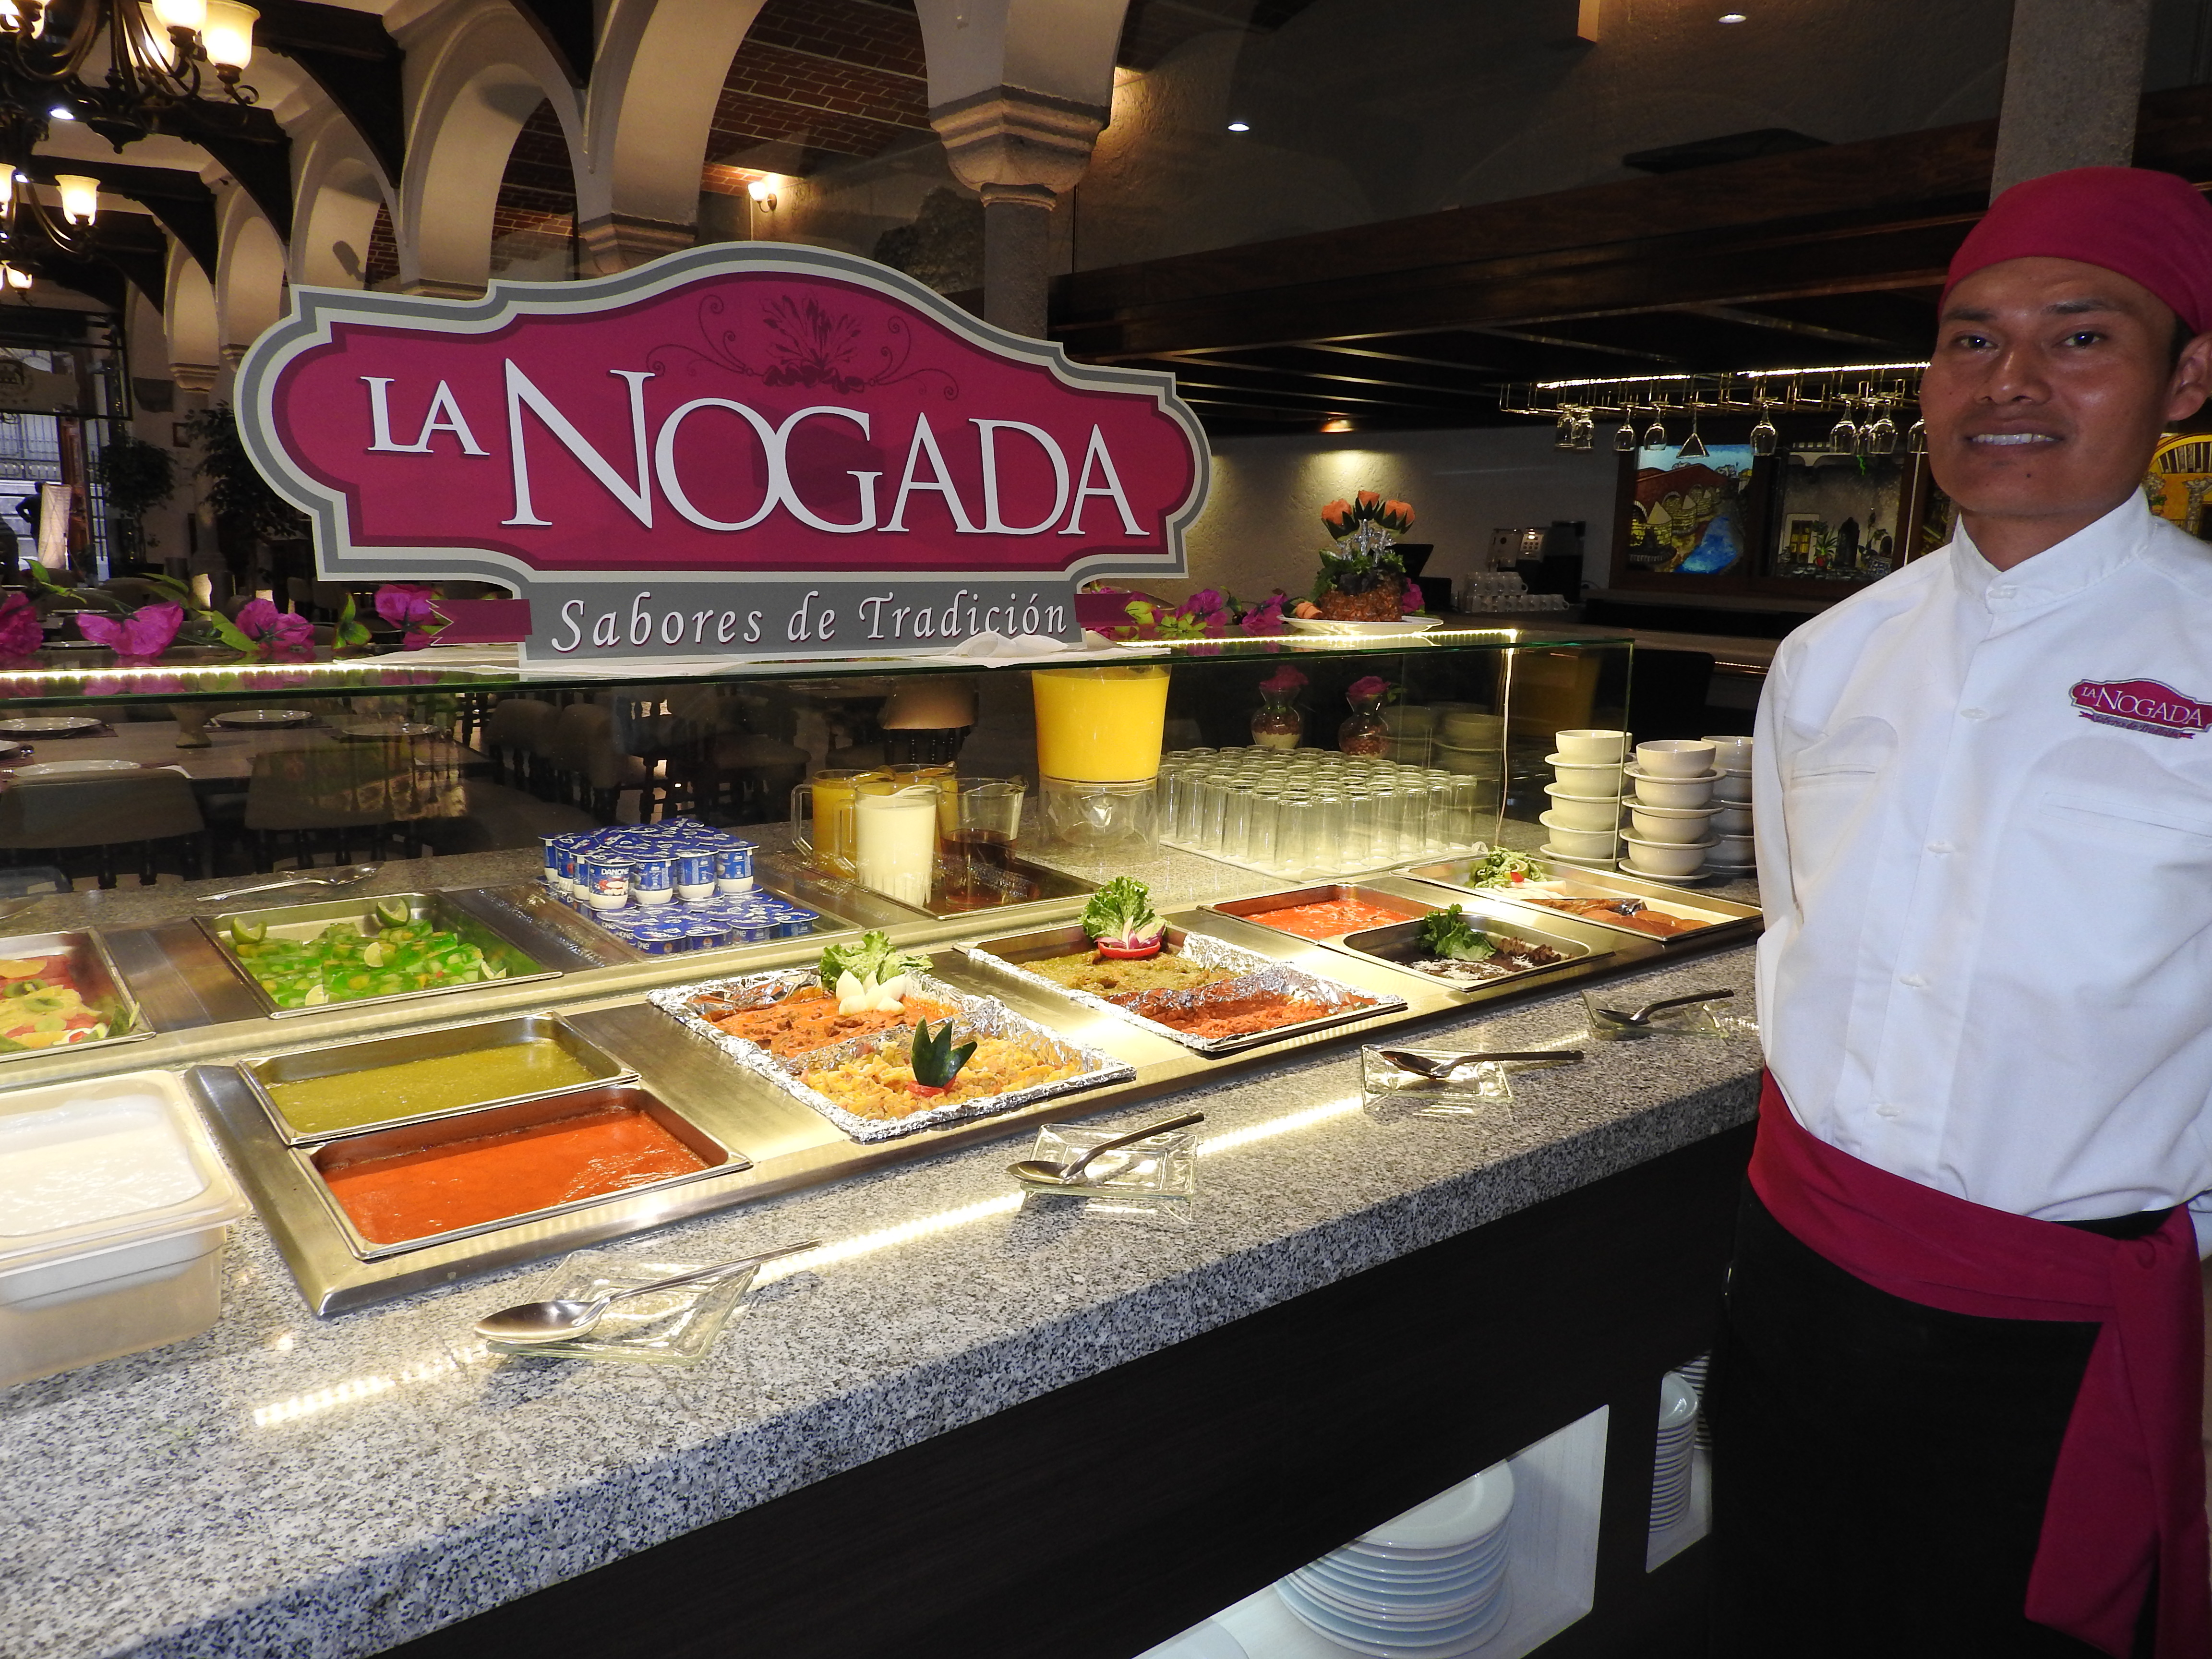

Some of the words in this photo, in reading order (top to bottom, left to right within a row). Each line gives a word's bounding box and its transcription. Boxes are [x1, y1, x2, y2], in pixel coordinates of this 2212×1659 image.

[360, 376, 490, 456] LA
[501, 358, 1150, 535] NOGADA
[551, 591, 763, 652] Sabores
[787, 590, 836, 640] de
[859, 589, 1067, 640] Tradición
[2081, 686, 2096, 698] LA
[2093, 687, 2203, 727] NOGADA
